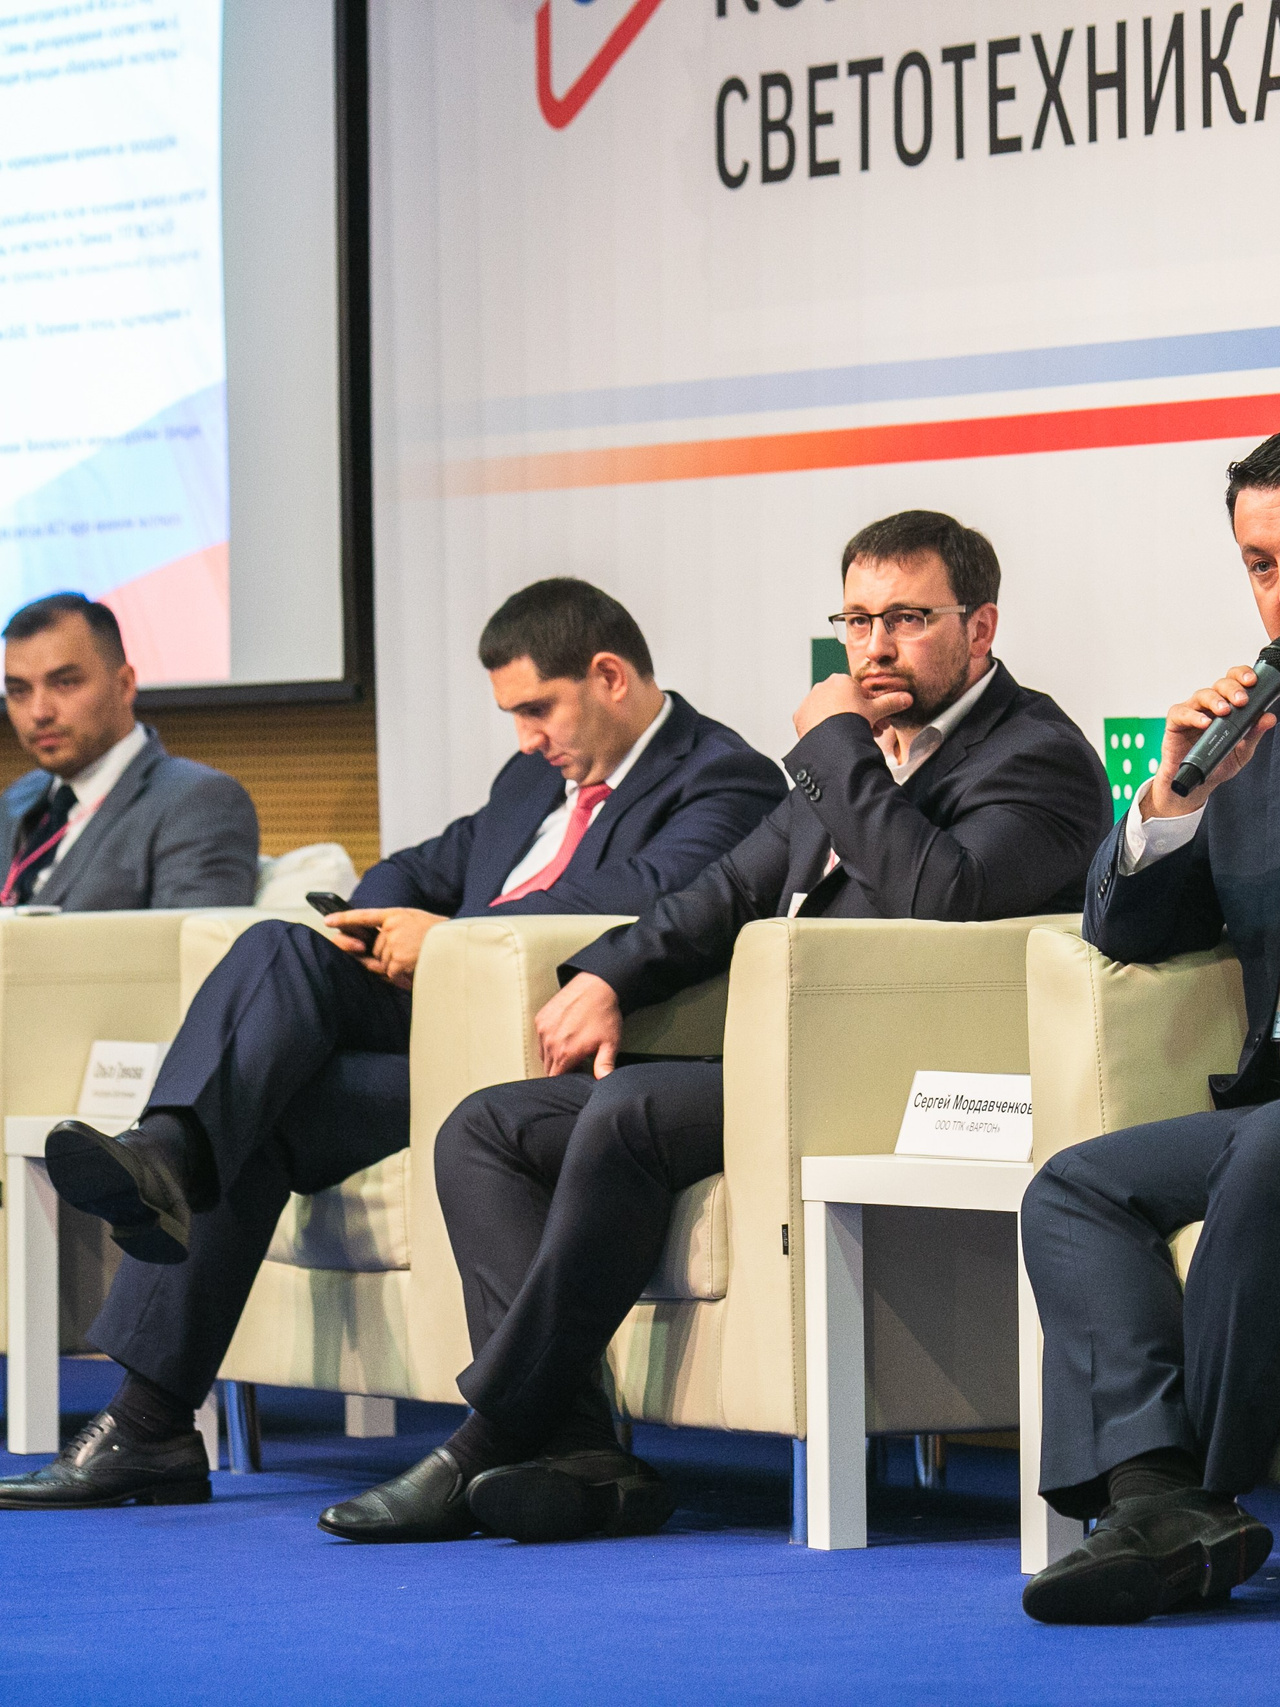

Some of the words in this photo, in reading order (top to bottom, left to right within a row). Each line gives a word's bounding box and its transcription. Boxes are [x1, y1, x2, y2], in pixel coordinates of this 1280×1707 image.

[913, 1092, 951, 1113] Сергей
[952, 1094, 1033, 1115] Мордавченков
[934, 1120, 950, 1131] ООО
[952, 1120, 965, 1131] ТПК
[966, 1121, 1000, 1133] «ВАРТОН»
